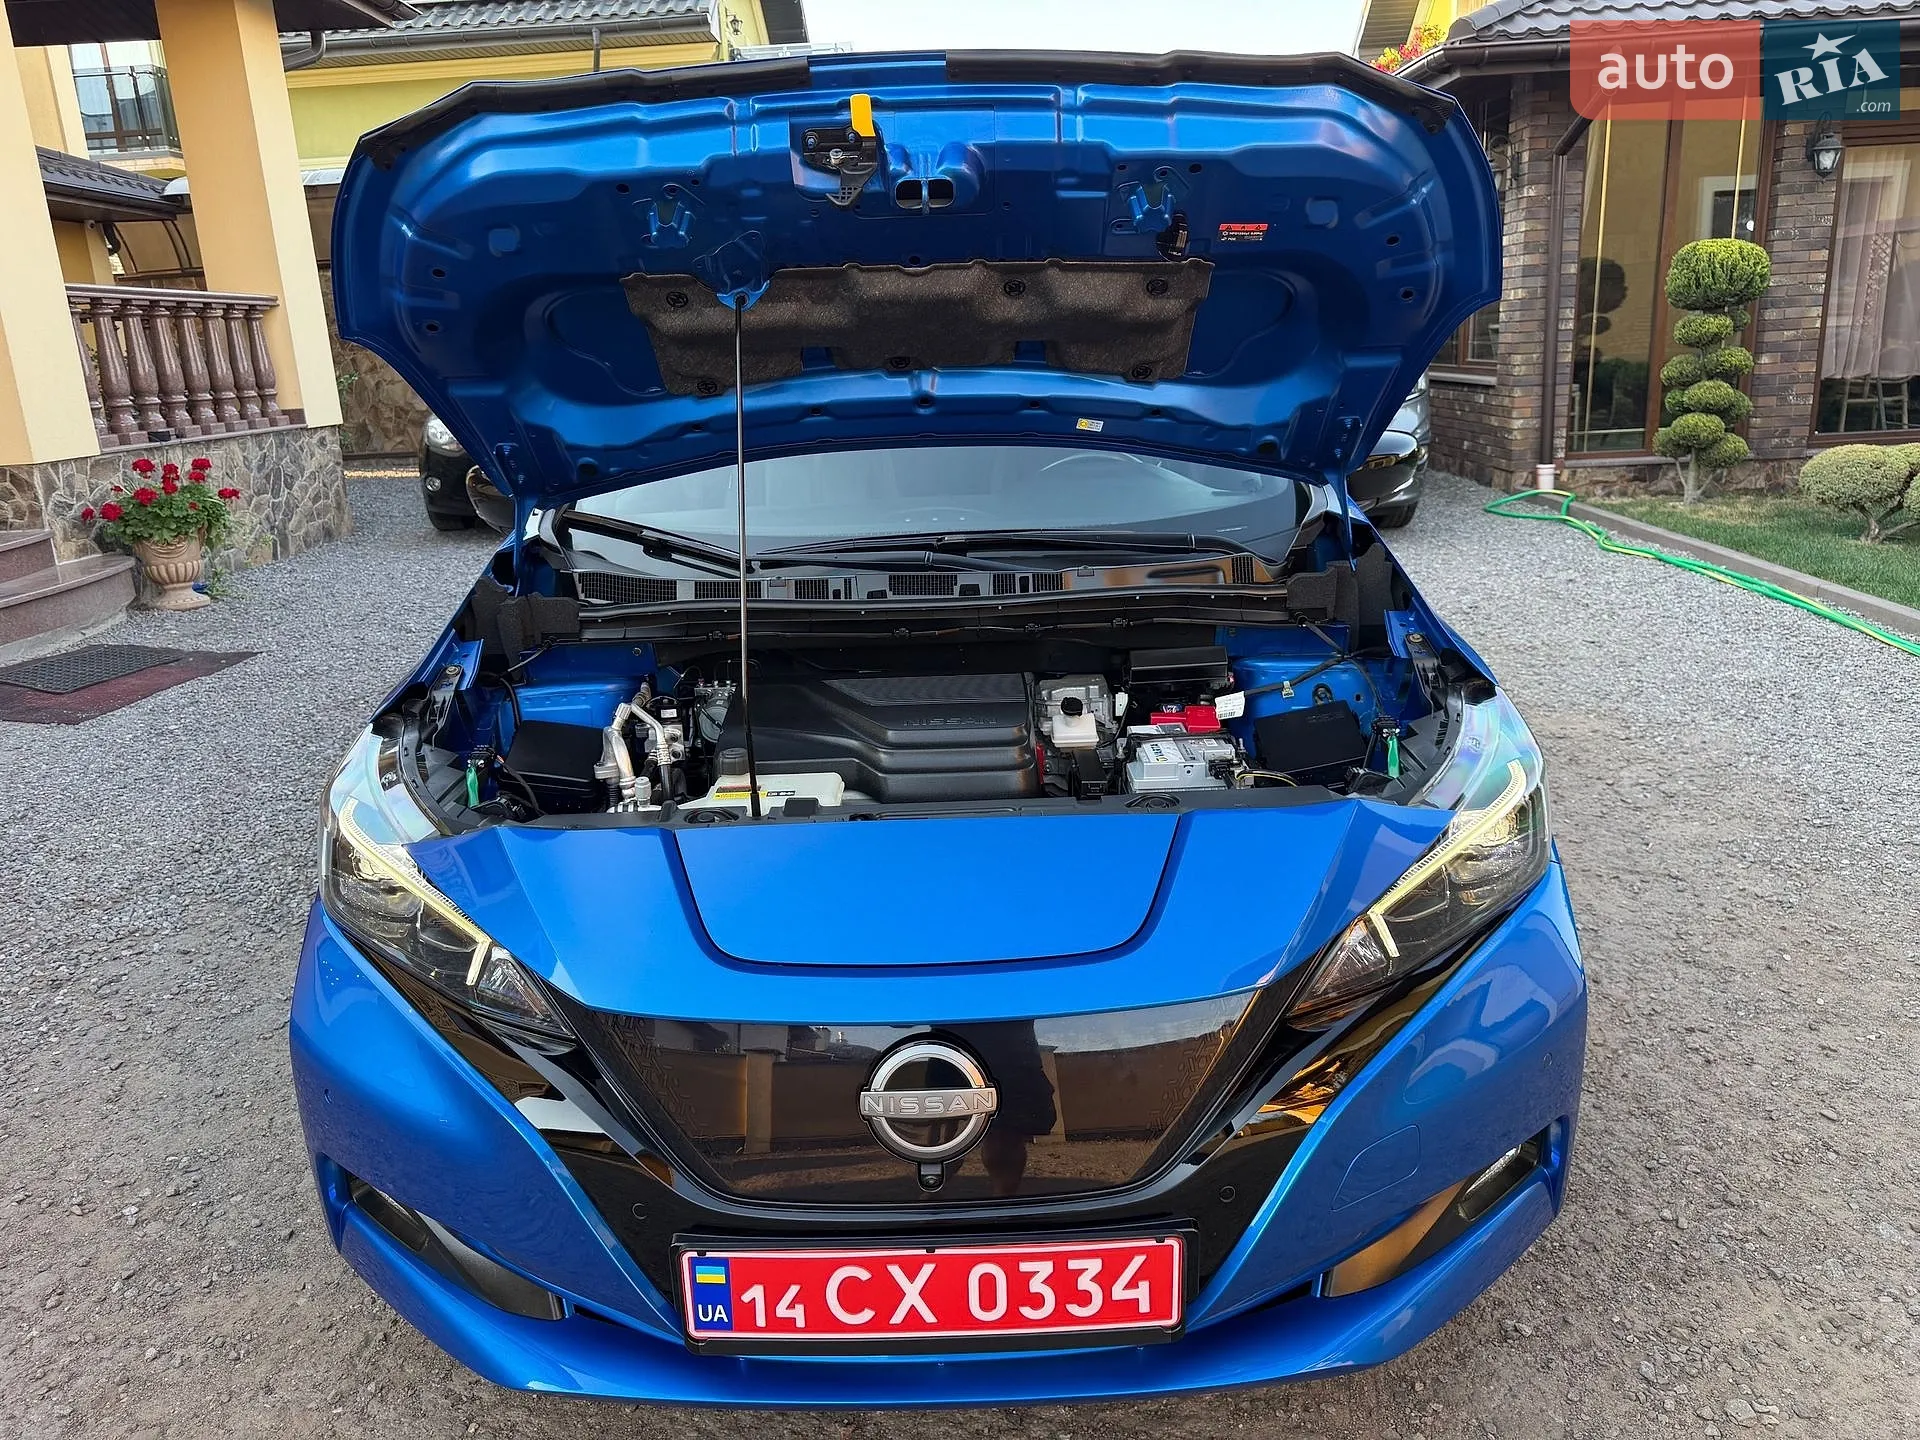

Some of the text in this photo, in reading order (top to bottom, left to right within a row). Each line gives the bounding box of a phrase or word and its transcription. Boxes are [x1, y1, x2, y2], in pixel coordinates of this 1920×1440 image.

[864, 1091, 994, 1115] NISSAN
[740, 1254, 1151, 1328] 14 CX 0334
[698, 1304, 729, 1323] UA
